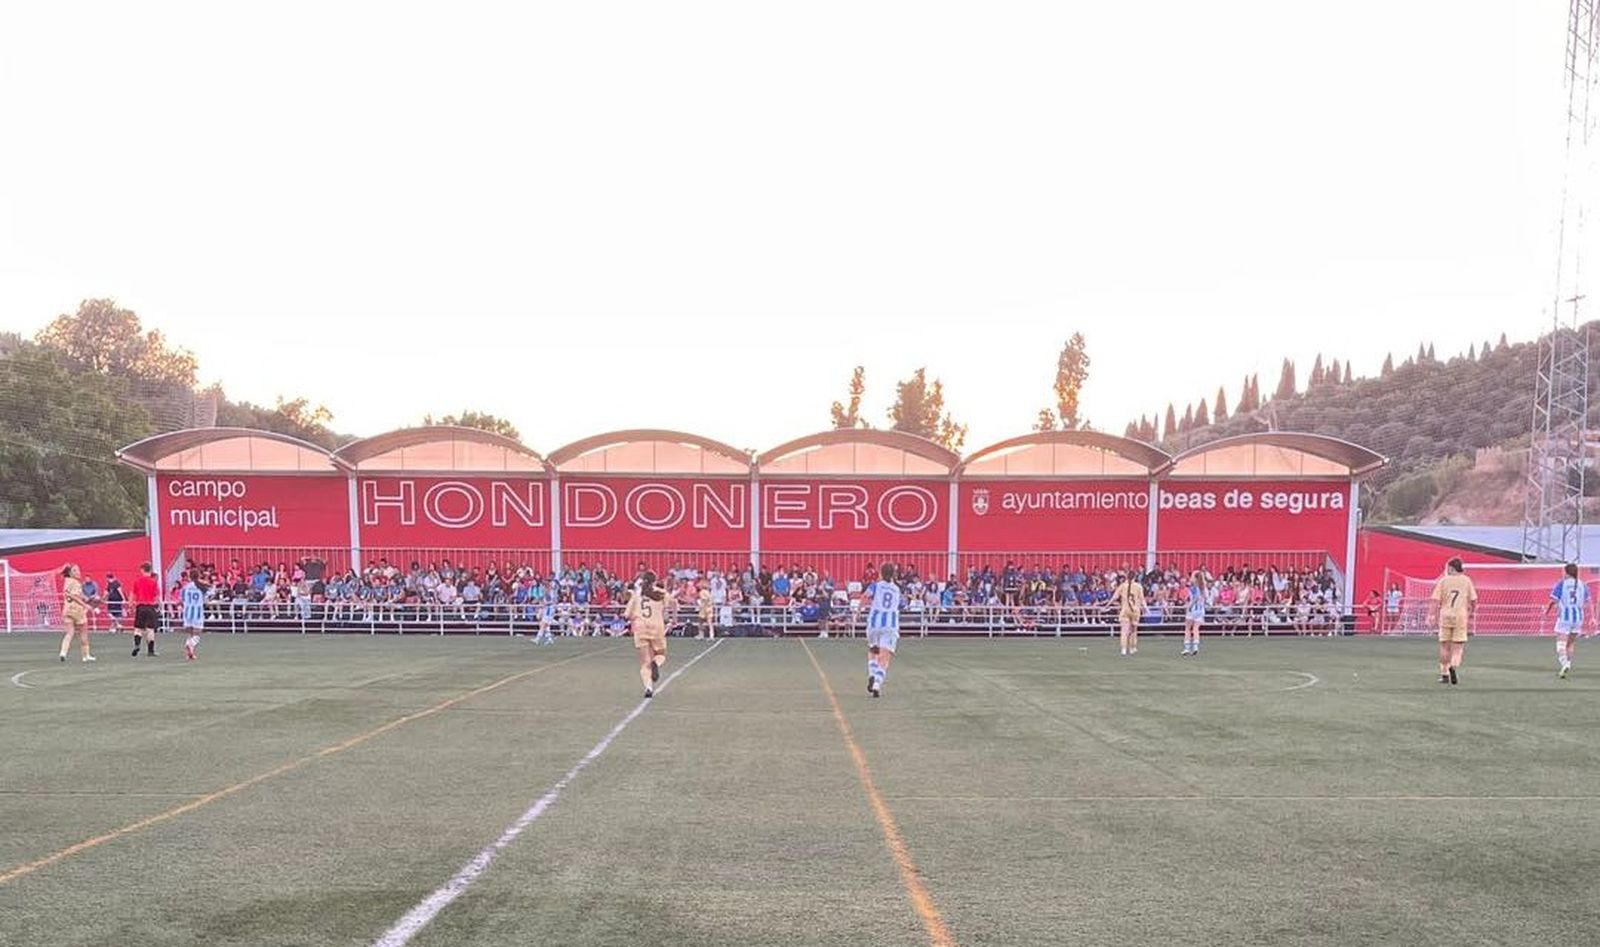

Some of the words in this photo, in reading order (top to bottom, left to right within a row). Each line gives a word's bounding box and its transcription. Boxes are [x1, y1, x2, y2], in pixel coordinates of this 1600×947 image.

[168, 480, 246, 502] campo
[1002, 491, 1149, 514] ayuntamiento
[1159, 489, 1217, 510] beas
[1223, 489, 1254, 510] de
[1260, 489, 1344, 514] segura
[362, 480, 938, 532] HONDONERO
[170, 505, 279, 532] municipal
[187, 591, 200, 603] 19
[881, 591, 893, 610] 8
[1449, 590, 1460, 608] 7
[641, 598, 652, 619] 5
